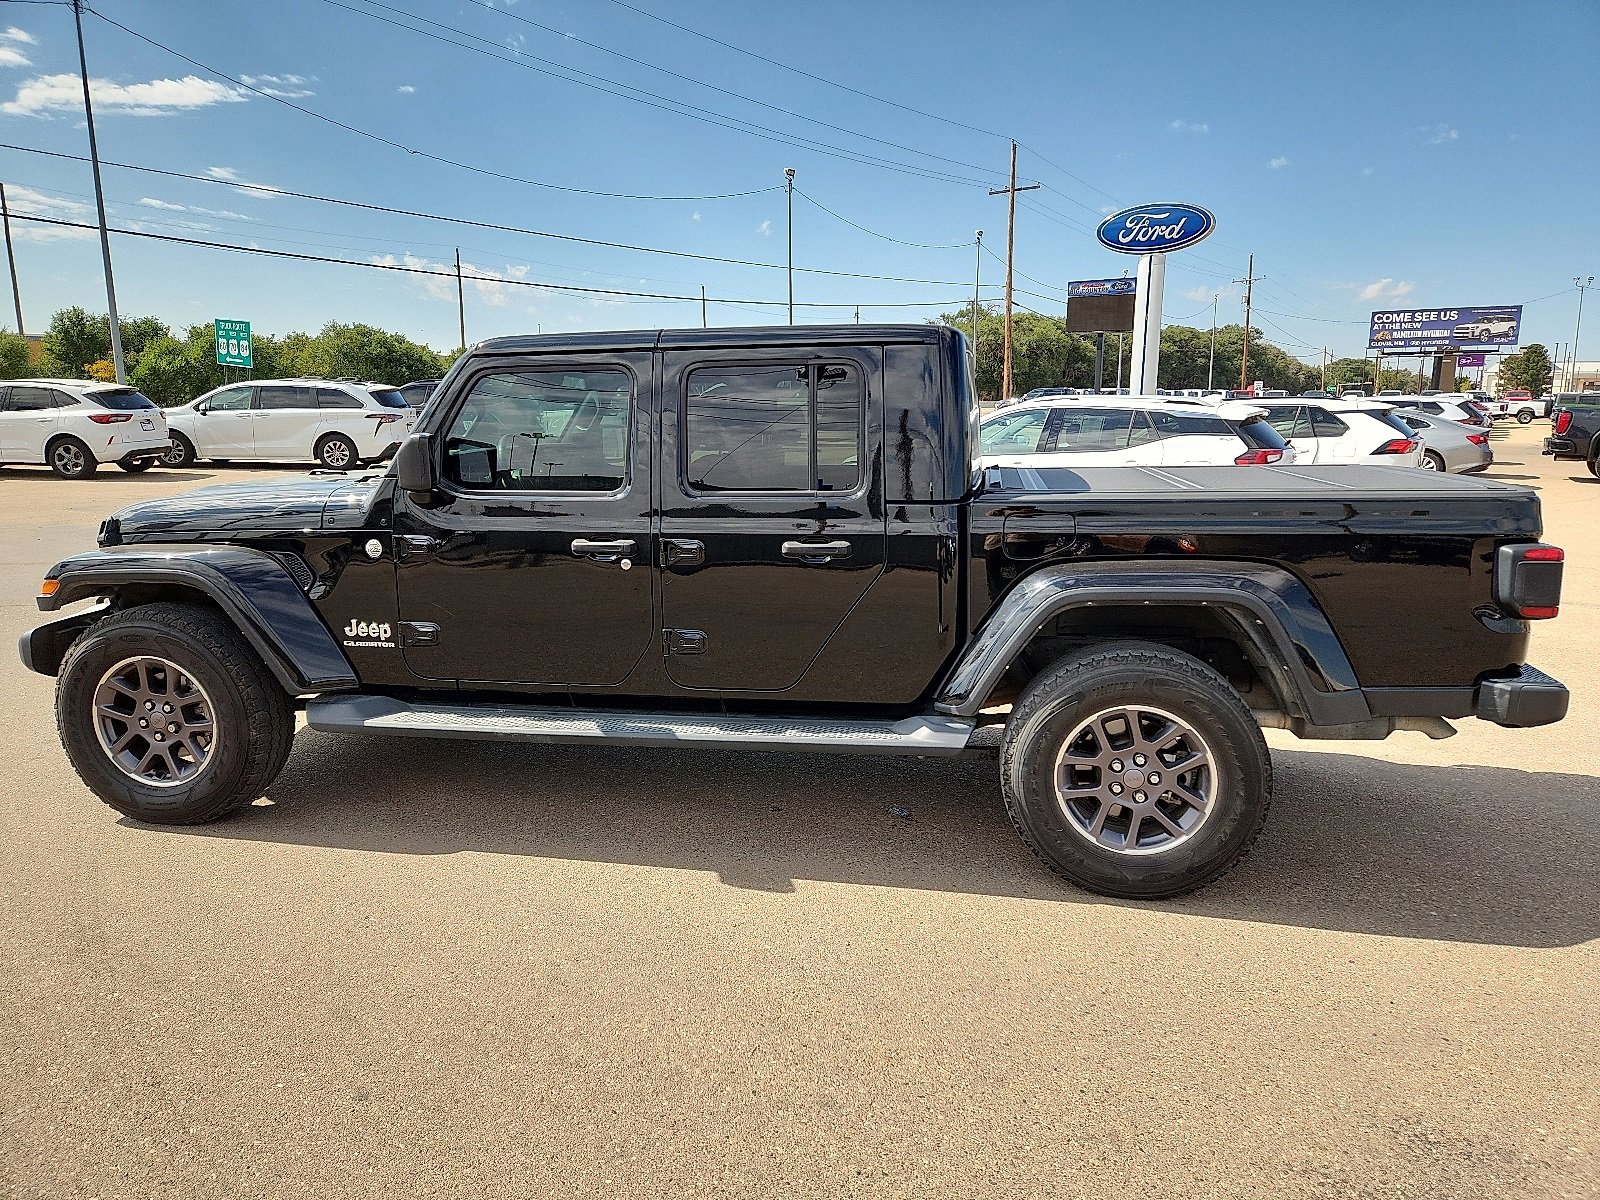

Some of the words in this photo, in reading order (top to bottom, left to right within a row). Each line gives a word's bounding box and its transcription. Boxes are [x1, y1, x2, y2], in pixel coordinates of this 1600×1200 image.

[1119, 212, 1187, 243] Ford
[1113, 281, 1130, 290] Ford
[1374, 312, 1413, 323] COME
[1414, 311, 1439, 321] SEE
[1441, 310, 1459, 320] US
[343, 619, 392, 641] Jeep
[343, 640, 396, 648] GLADIATOR
